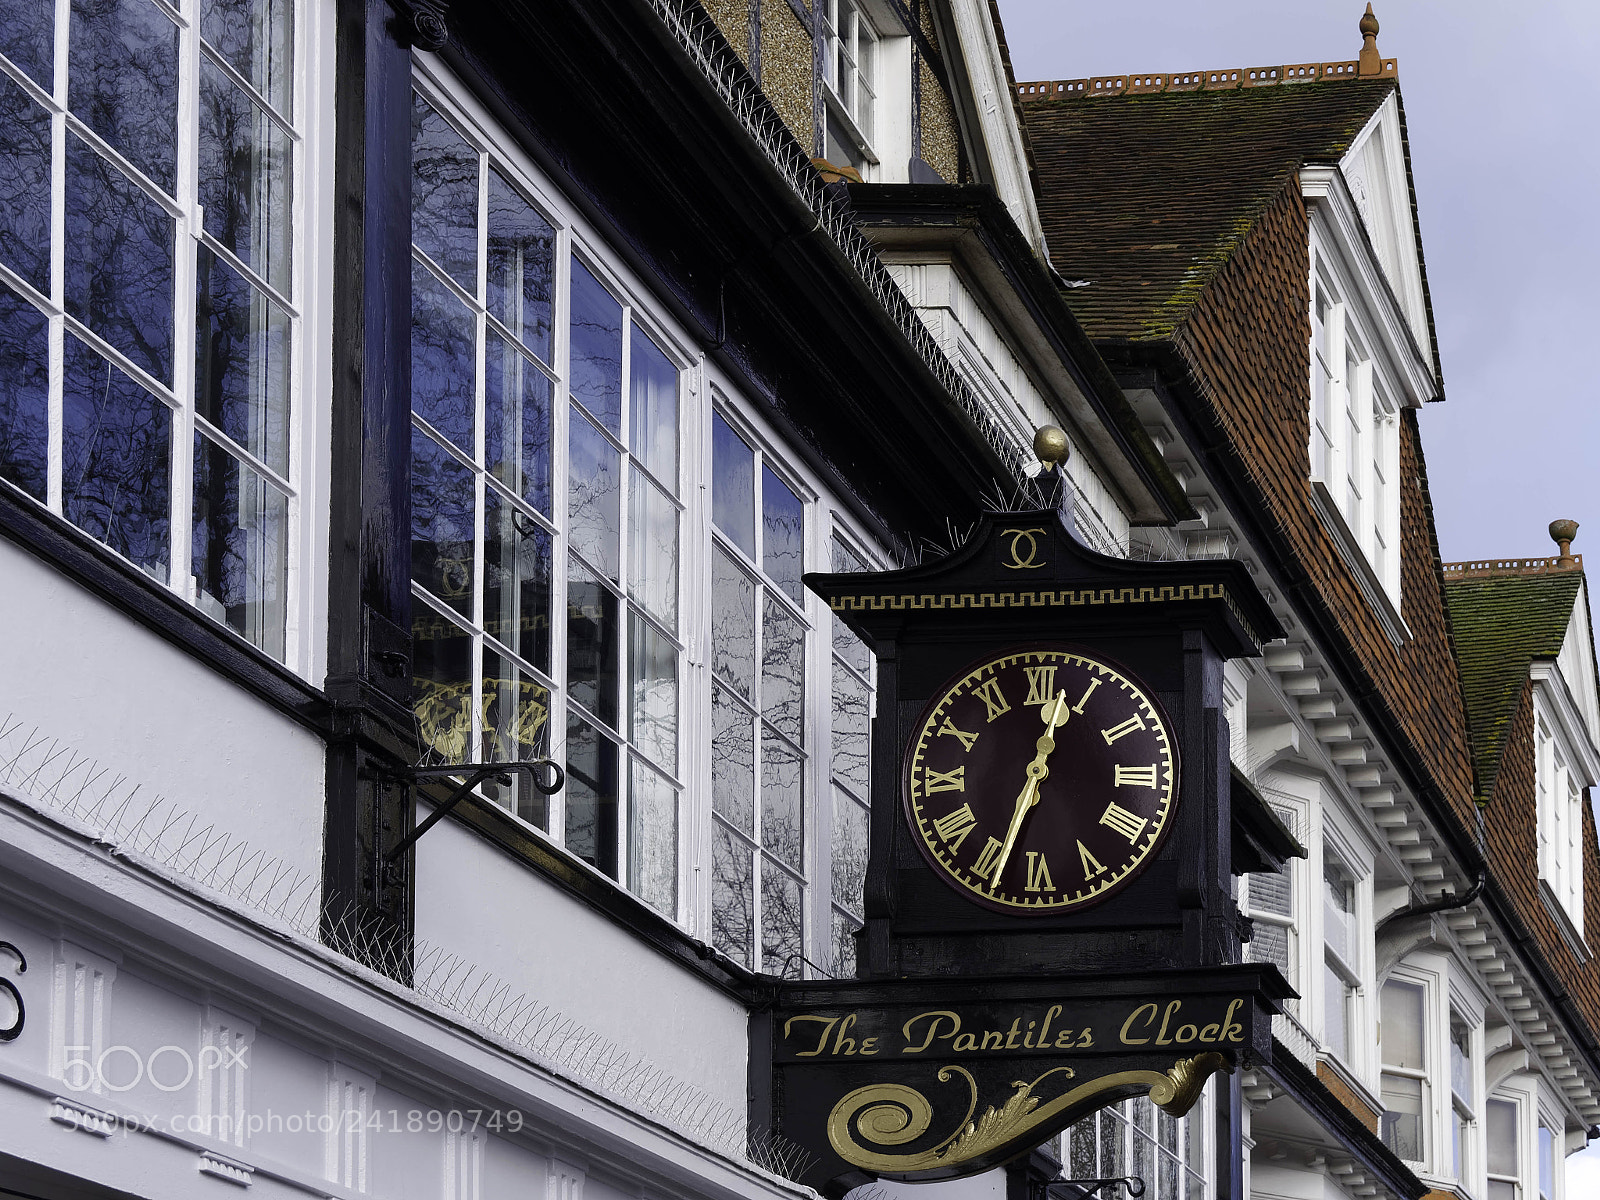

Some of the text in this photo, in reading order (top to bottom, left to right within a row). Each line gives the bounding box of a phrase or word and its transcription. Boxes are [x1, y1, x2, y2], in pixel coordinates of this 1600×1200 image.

[971, 676, 1012, 723] XI
[1023, 666, 1058, 706] XII
[1071, 677, 1103, 715] I
[937, 716, 980, 752] X
[1101, 713, 1147, 746] II
[925, 765, 965, 797] IX
[1114, 763, 1157, 789] III
[933, 802, 978, 856] VIII
[1099, 801, 1149, 845] IIII
[1024, 851, 1057, 892] VI
[1076, 838, 1108, 881] V
[784, 998, 1247, 1057] The Pantiles Clock
